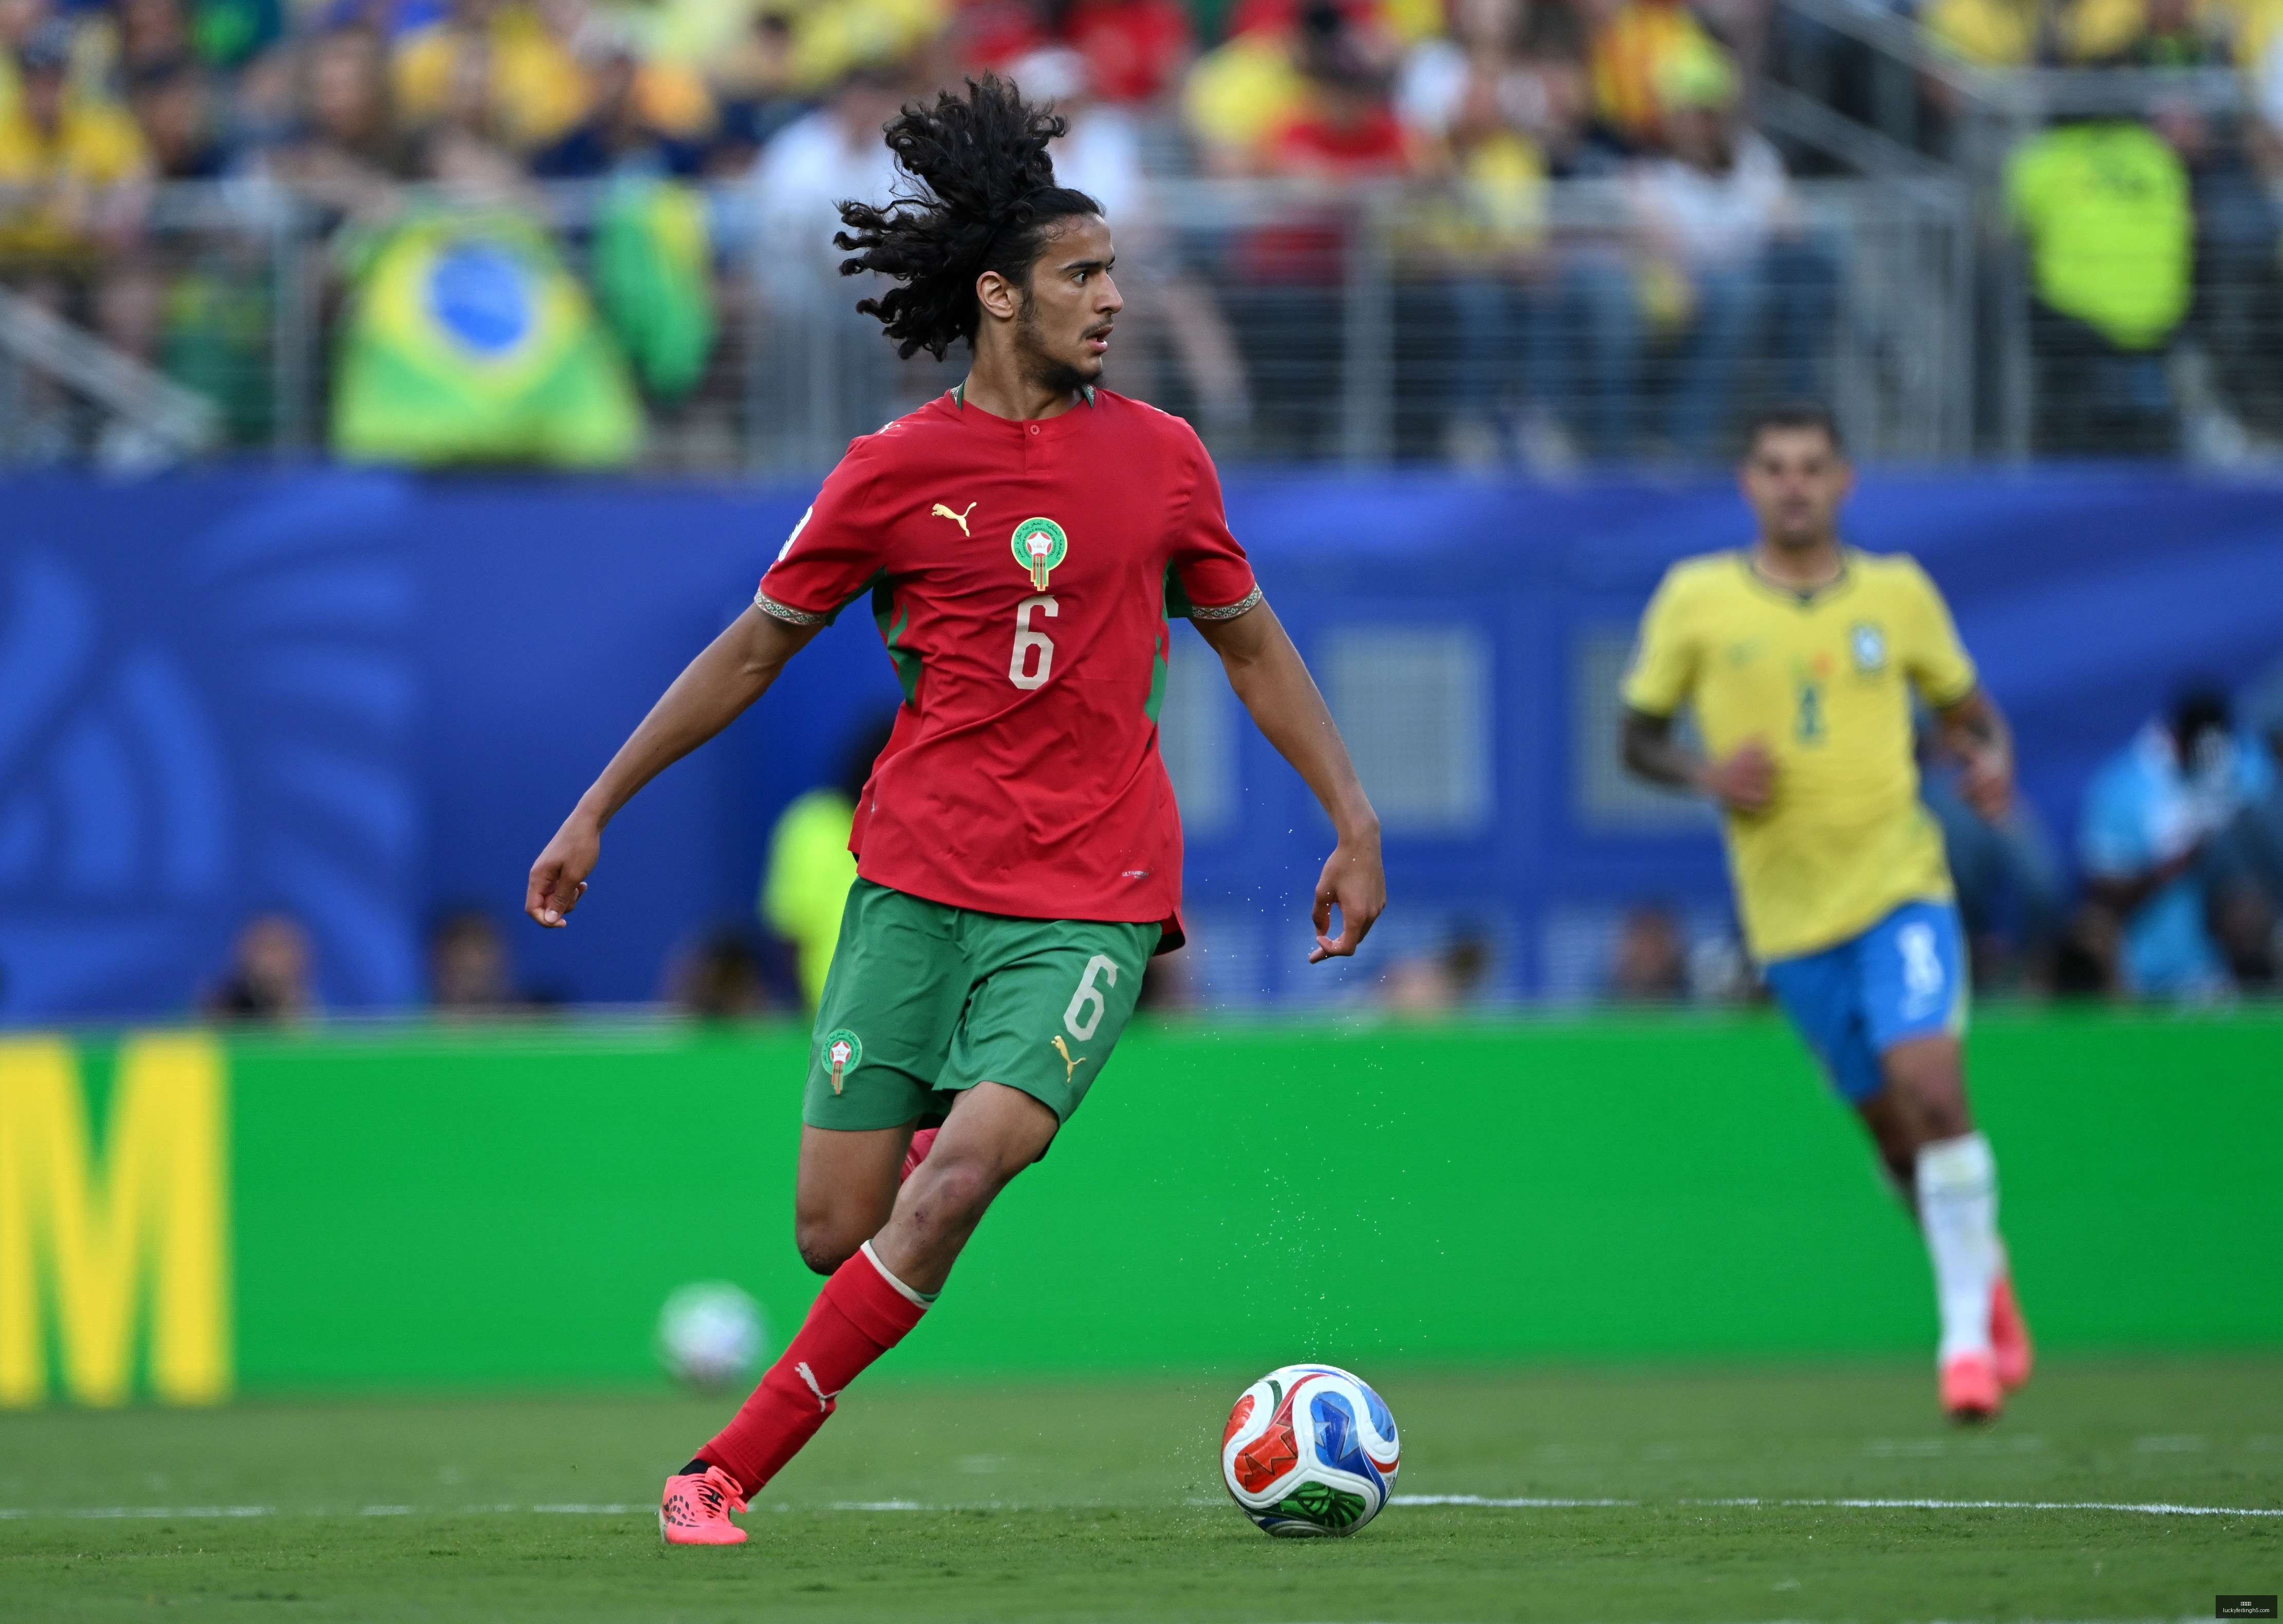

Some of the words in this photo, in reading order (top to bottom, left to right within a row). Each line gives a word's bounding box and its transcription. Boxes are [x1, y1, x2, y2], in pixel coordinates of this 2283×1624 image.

[1009, 594, 1059, 690] 6
[1063, 955, 1119, 1041] 6
[0, 1034, 229, 1403] M
